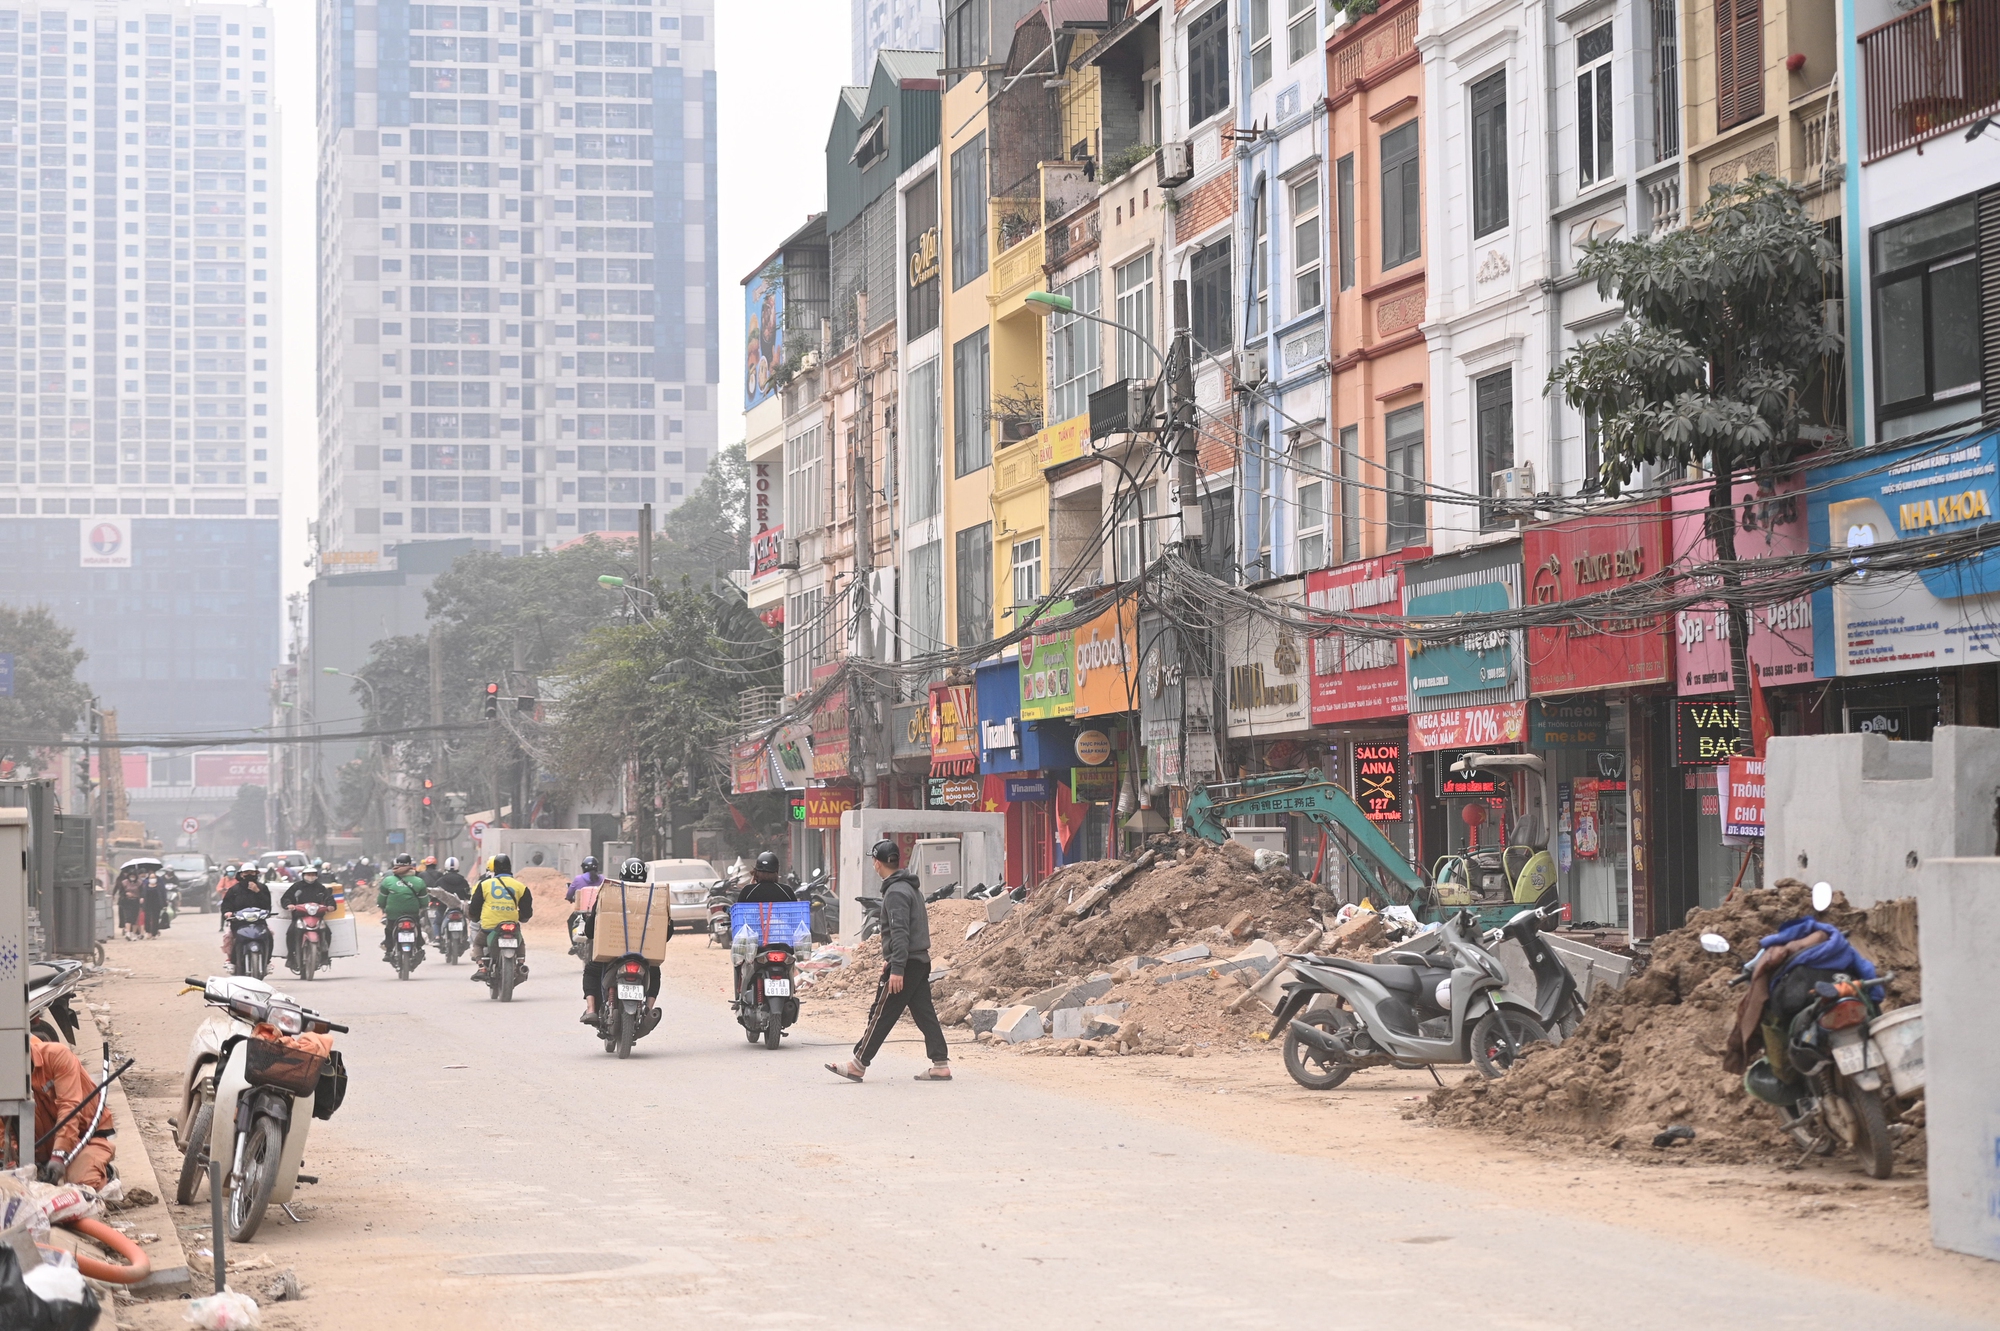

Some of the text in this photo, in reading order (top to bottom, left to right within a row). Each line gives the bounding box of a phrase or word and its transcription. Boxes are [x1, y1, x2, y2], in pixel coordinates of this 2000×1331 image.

[1930, 452, 1949, 468] RĂNG
[1966, 445, 1982, 462] MẶT
[756, 463, 769, 535] KOREA
[1900, 490, 1989, 530] NHA KHOA
[1571, 546, 1643, 585] VÀNG BẠC
[1678, 611, 1704, 653] Spa
[1417, 710, 1460, 729] MEGA SALE
[1548, 719, 1569, 728] THỐNG
[1570, 719, 1582, 728] CỬA
[1584, 719, 1602, 728] HÀNG
[1691, 704, 1739, 728] VÀN
[982, 717, 1016, 750] Vinamilk
[1465, 708, 1498, 743] 70%
[1424, 730, 1454, 746] CUỐI NĂM
[1545, 732, 1567, 745] mẹ
[1578, 729, 1597, 742] bé
[1357, 746, 1398, 759] SALON
[229, 765, 245, 775] GX
[1361, 761, 1395, 774] ANNA
[1011, 784, 1044, 793] Vinamilk
[808, 797, 852, 815] VÀNG
[1369, 798, 1389, 810] 127
[1702, 795, 1718, 815] 9999
[1735, 806, 1757, 821] CHÓ
[1728, 825, 1739, 835] ĐT:
[1740, 826, 1758, 836] 0353
[491, 881, 515, 900] be
[768, 980, 786, 988] 35-AA
